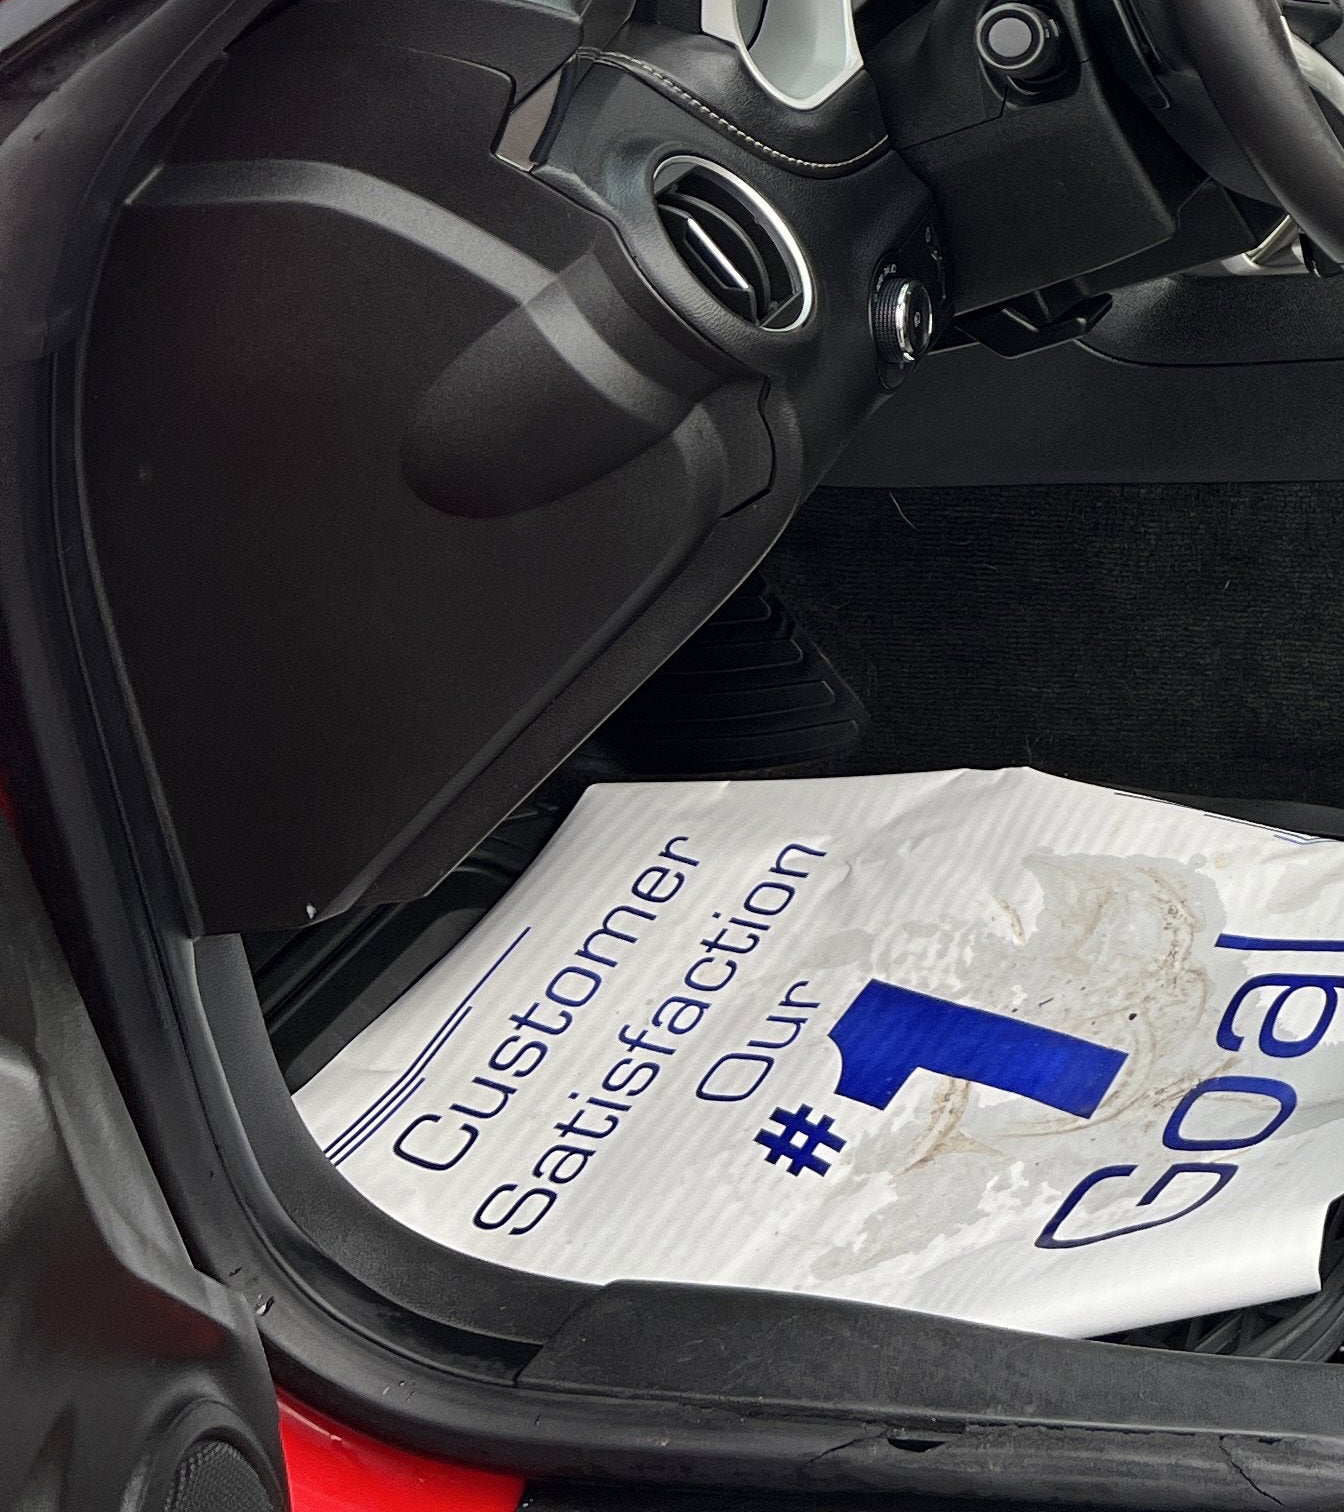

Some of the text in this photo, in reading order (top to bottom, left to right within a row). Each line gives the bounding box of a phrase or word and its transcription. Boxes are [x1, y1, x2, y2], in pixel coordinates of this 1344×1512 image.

[393, 835, 700, 1170] Customer
[472, 843, 827, 1235] Satisfaction
[696, 980, 821, 1102] Our
